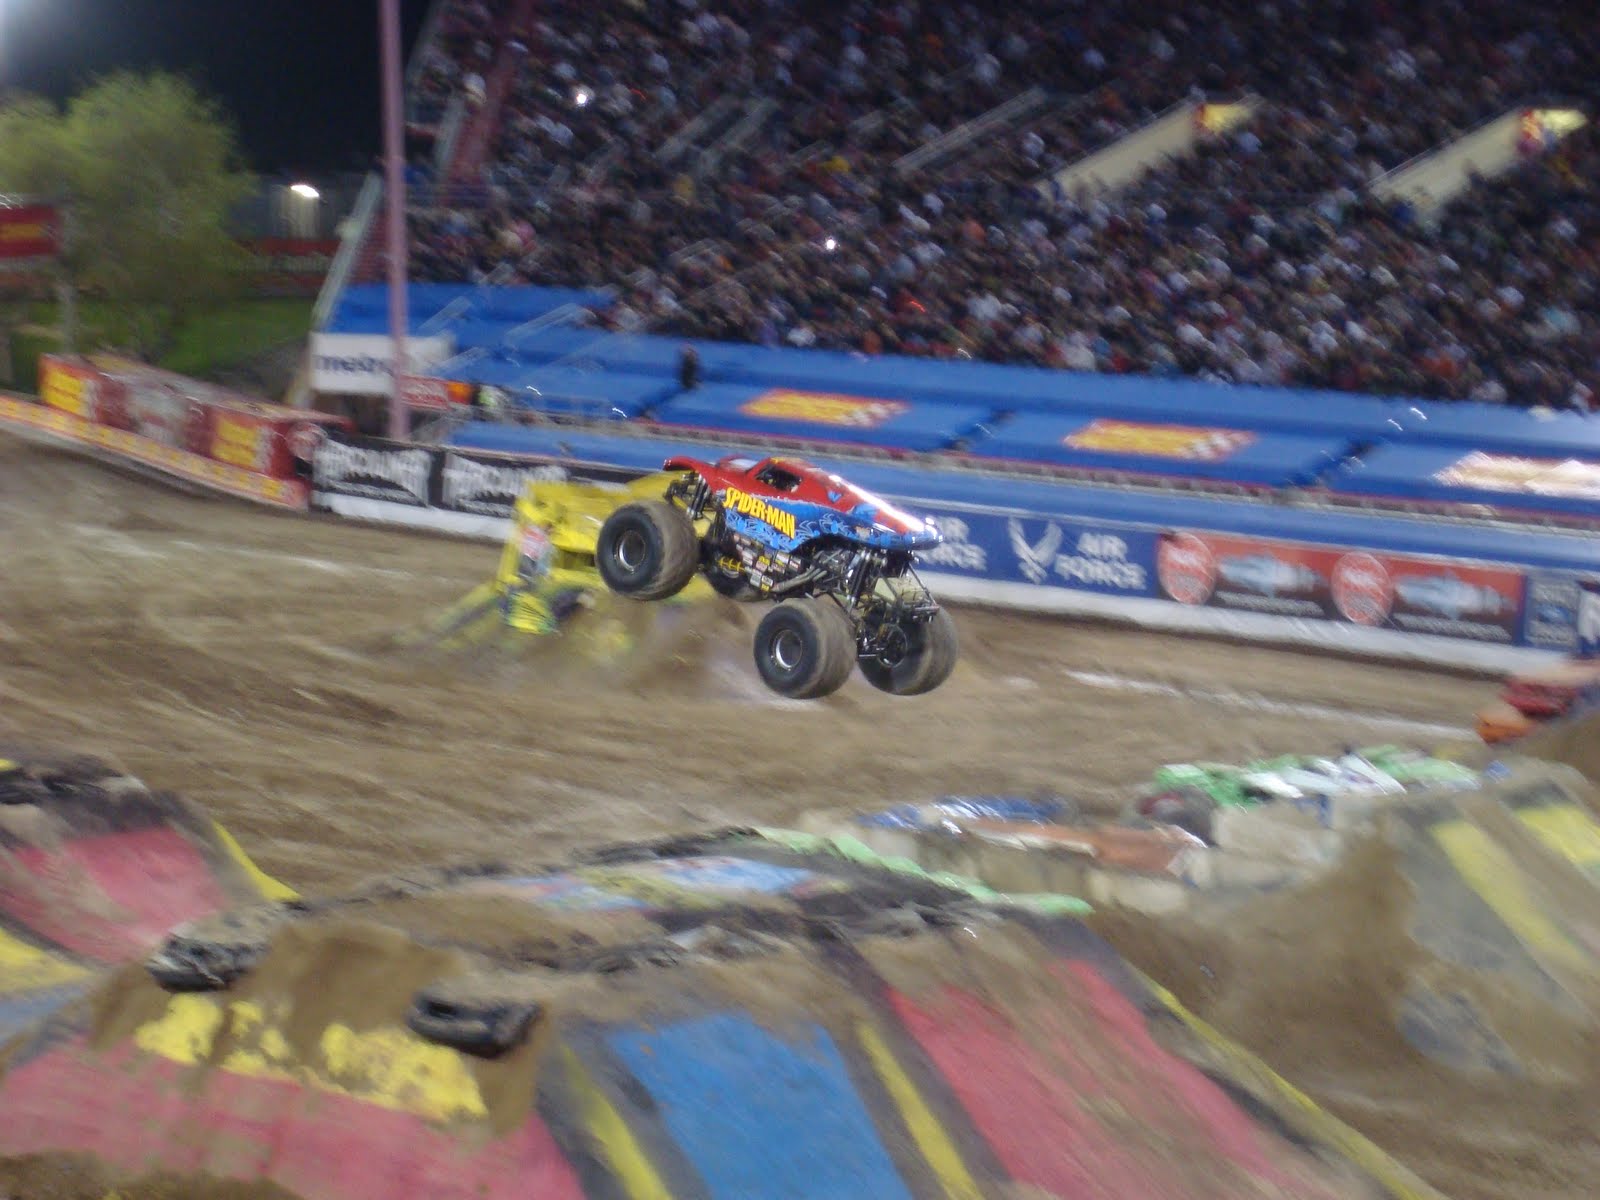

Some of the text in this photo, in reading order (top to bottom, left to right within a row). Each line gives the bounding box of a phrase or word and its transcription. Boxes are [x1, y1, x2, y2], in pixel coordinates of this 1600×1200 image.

[722, 486, 796, 540] SPIDER-MAN
[1076, 532, 1129, 562] AIR
[1054, 553, 1148, 590] FORCE
